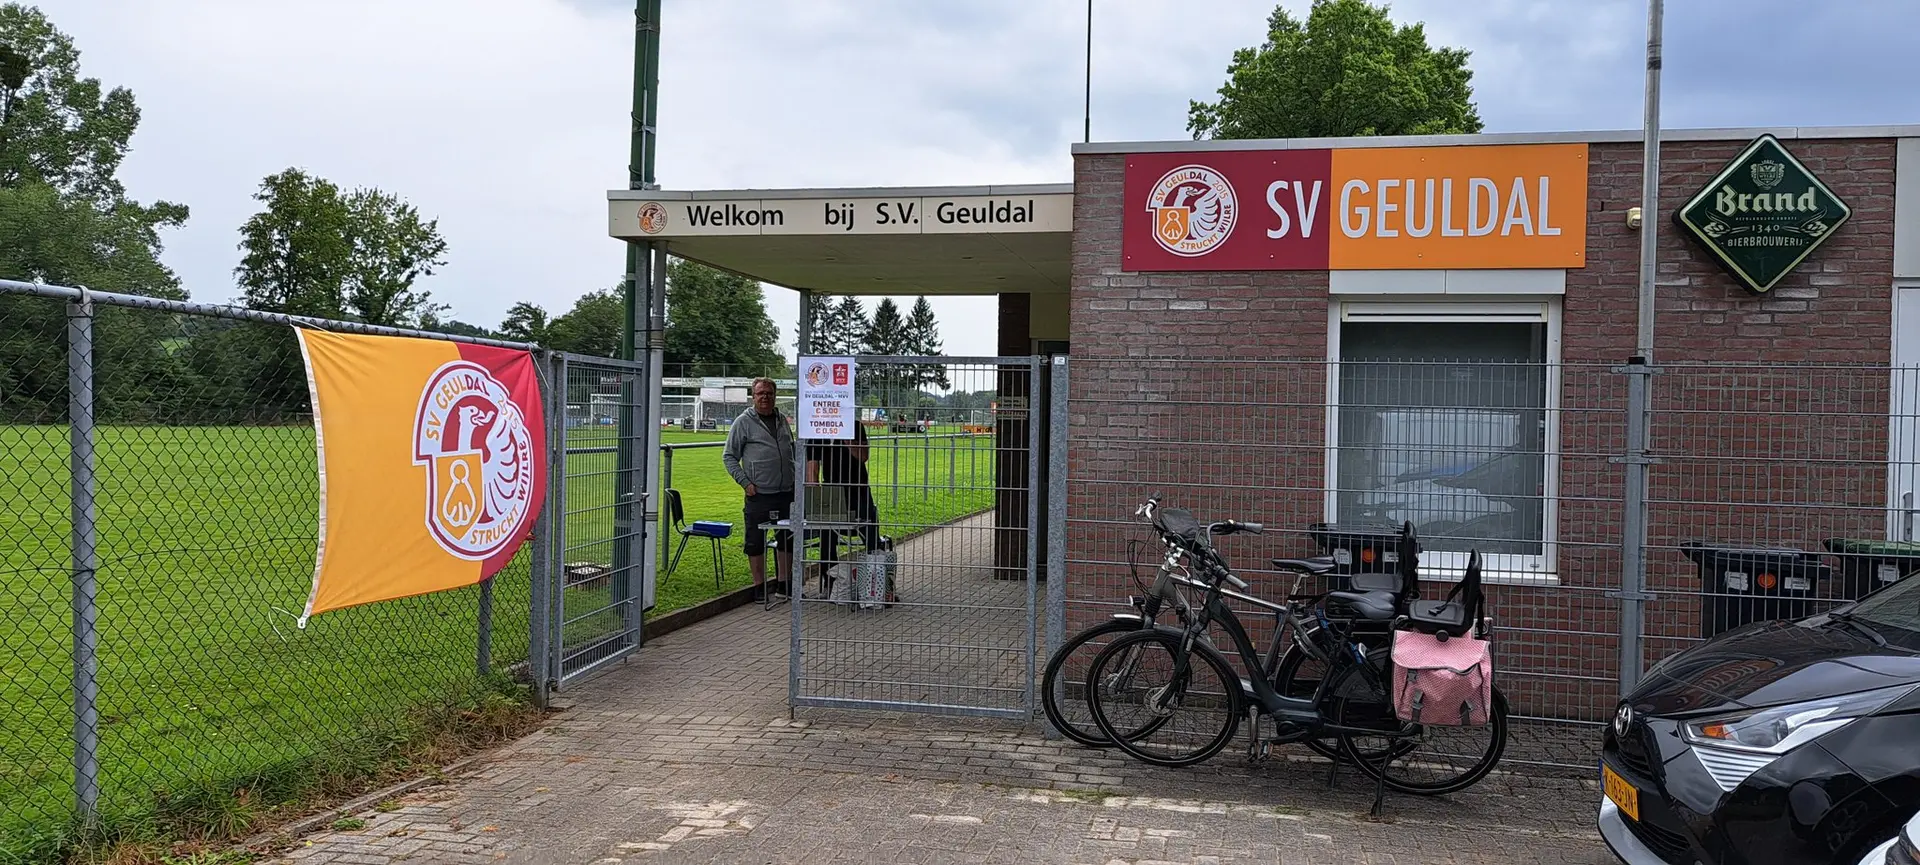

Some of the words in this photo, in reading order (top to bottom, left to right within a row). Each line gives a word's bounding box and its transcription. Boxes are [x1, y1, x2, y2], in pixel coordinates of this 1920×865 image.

[1155, 189, 1166, 202] SV
[1165, 171, 1208, 189] GEULDAL
[1212, 180, 1228, 200] 2015
[1715, 184, 1818, 217] Brand
[686, 203, 784, 227] Welkom
[825, 203, 855, 230] bij
[876, 202, 919, 224] S.V.
[936, 200, 1034, 224] Geuldal
[1266, 180, 1322, 239] SV
[1339, 176, 1561, 238] GEULDAL
[1180, 233, 1219, 250] STRUCHT
[1217, 204, 1232, 234] WIJLRE
[1727, 236, 1803, 247] BIERBROUWERIJ
[1751, 224, 1780, 234] 1340
[426, 411, 442, 441] SV
[435, 373, 490, 410] GEULDAL
[469, 503, 520, 546] STRUCHT
